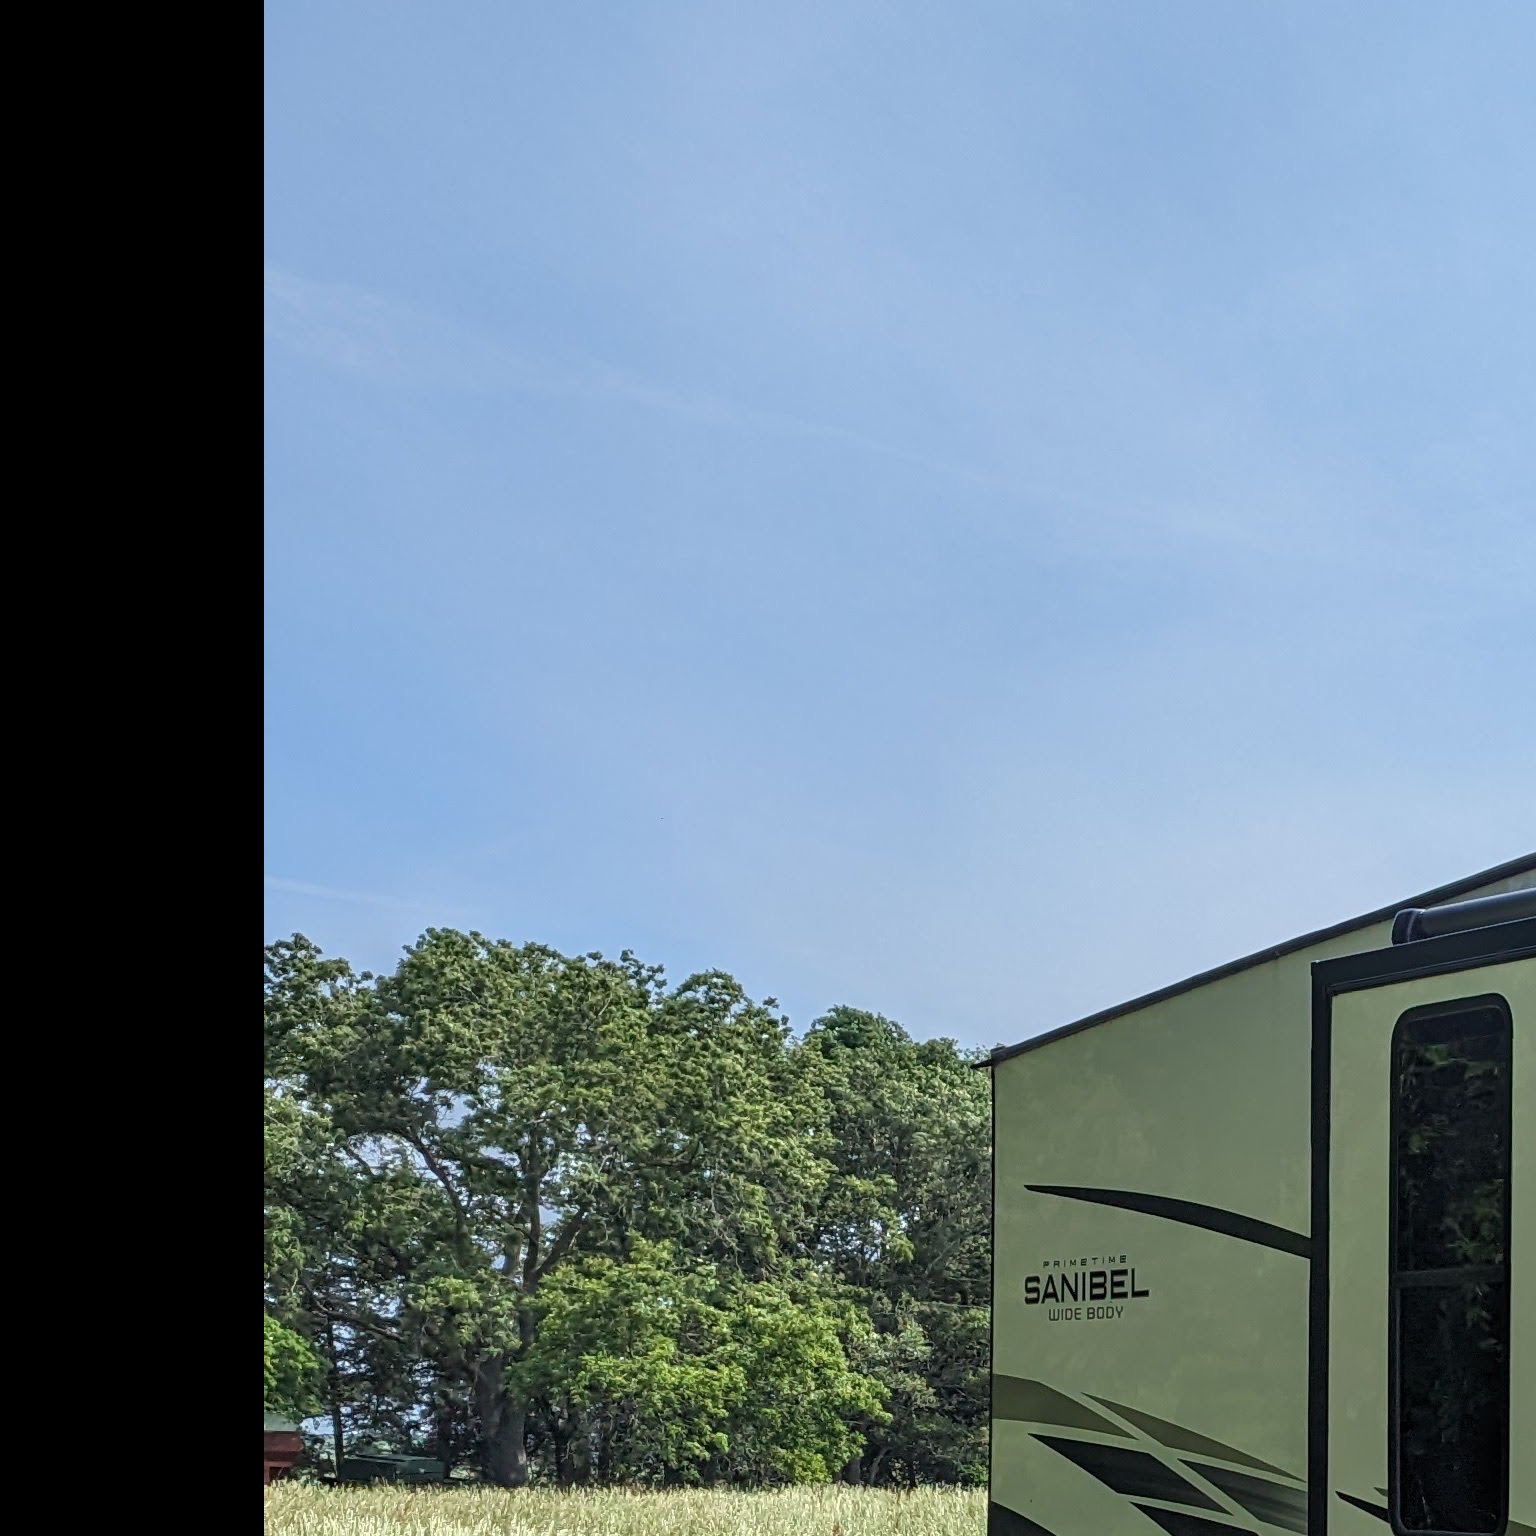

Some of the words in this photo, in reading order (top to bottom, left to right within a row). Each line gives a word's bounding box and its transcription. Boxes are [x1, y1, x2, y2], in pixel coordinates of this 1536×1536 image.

[1024, 1267, 1150, 1305] SANIBEL
[1048, 1307, 1082, 1322] WIDE
[1086, 1305, 1124, 1320] BODY
